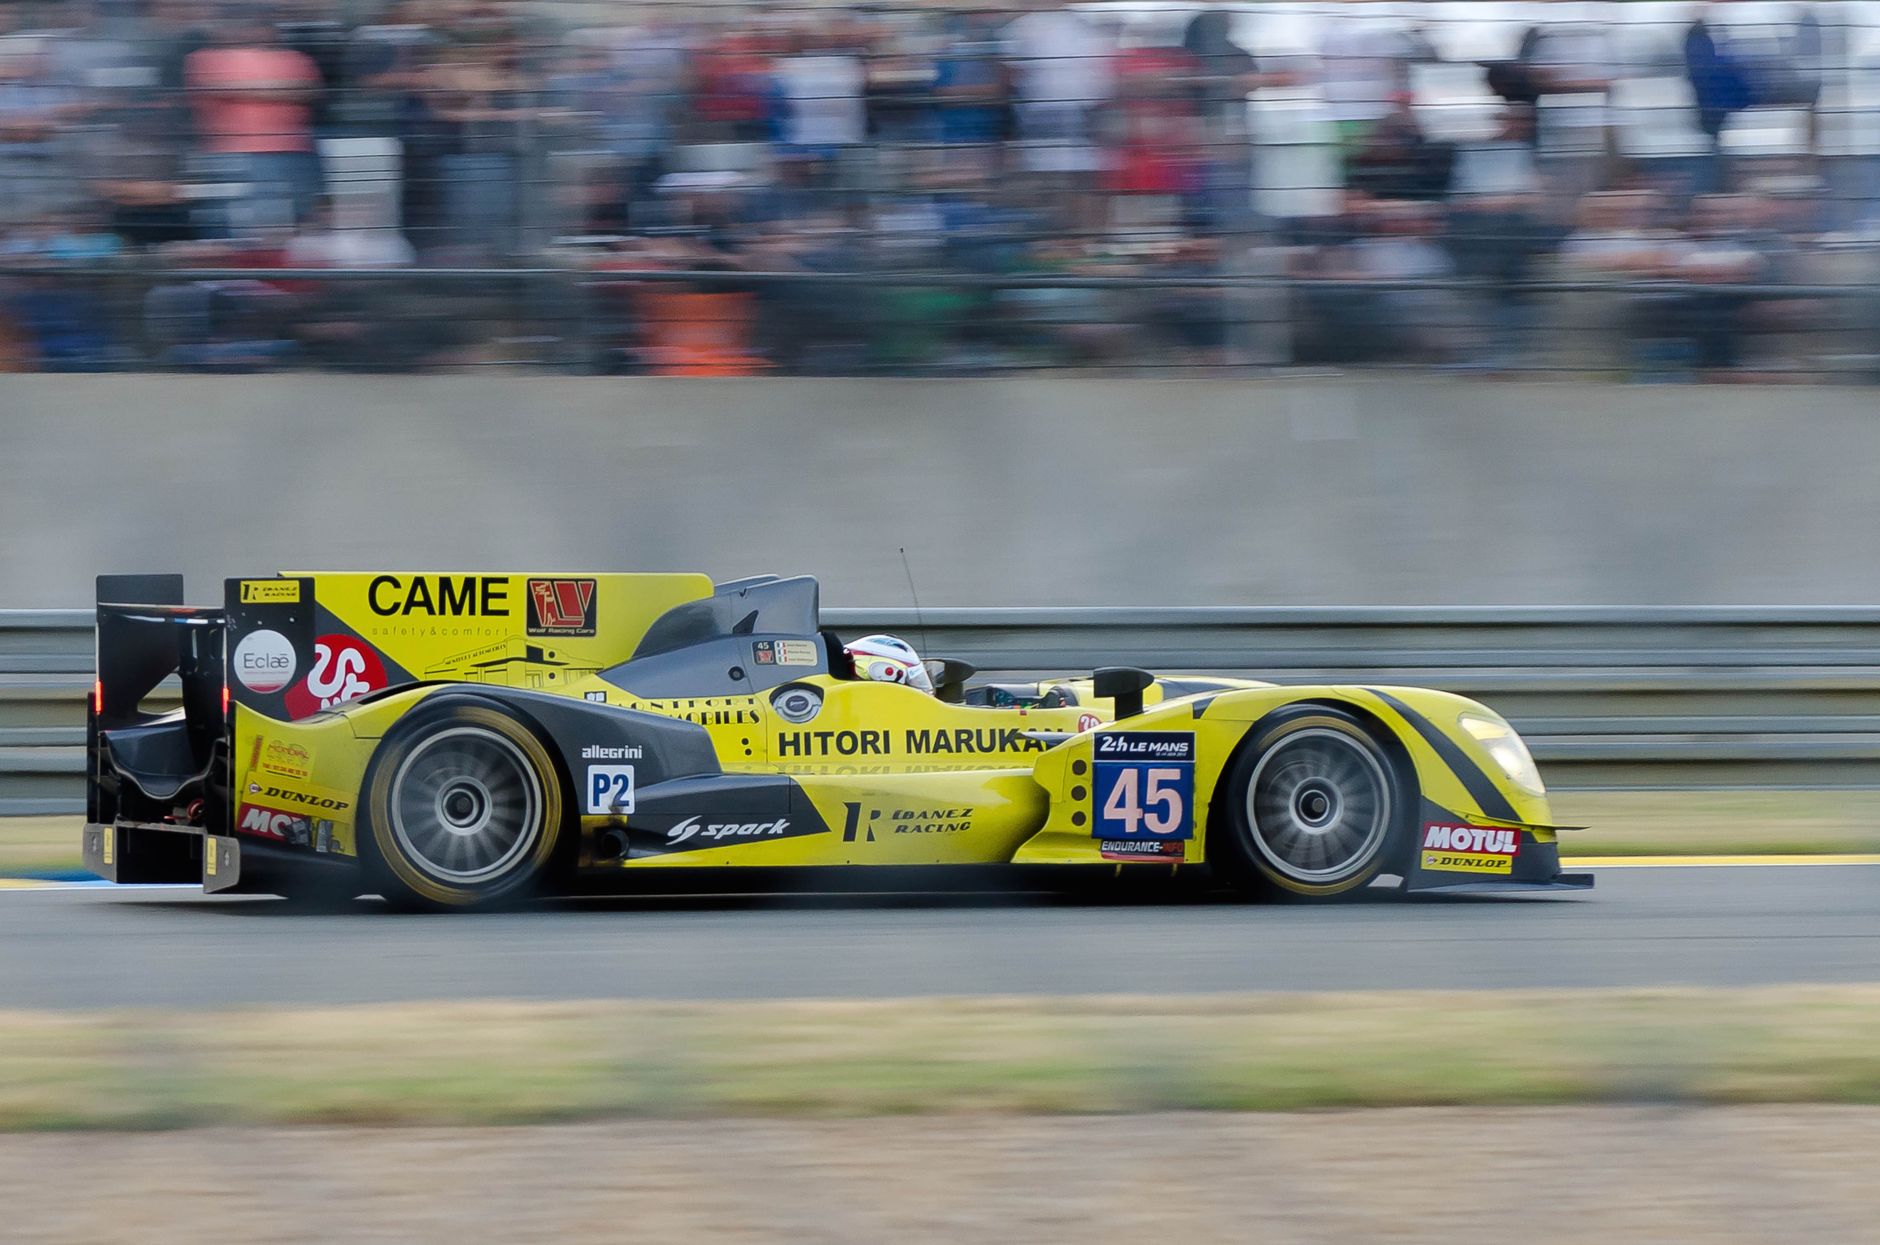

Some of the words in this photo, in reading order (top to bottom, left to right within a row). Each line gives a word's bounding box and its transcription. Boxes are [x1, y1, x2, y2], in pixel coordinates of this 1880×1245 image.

[368, 575, 510, 617] CAME
[757, 641, 770, 650] 45
[581, 745, 643, 759] allegrini
[778, 730, 890, 756] HITORI
[1129, 742, 1148, 752] LE
[1148, 742, 1189, 752] MANS
[264, 786, 349, 810] DUNLOP
[592, 773, 630, 807] P2
[1103, 768, 1183, 834] 45
[892, 808, 973, 820] IBANEZ
[700, 818, 790, 840] spark
[894, 821, 972, 834] RACING
[1423, 825, 1518, 853] MOTUL
[1439, 857, 1507, 868] DUNLOP
